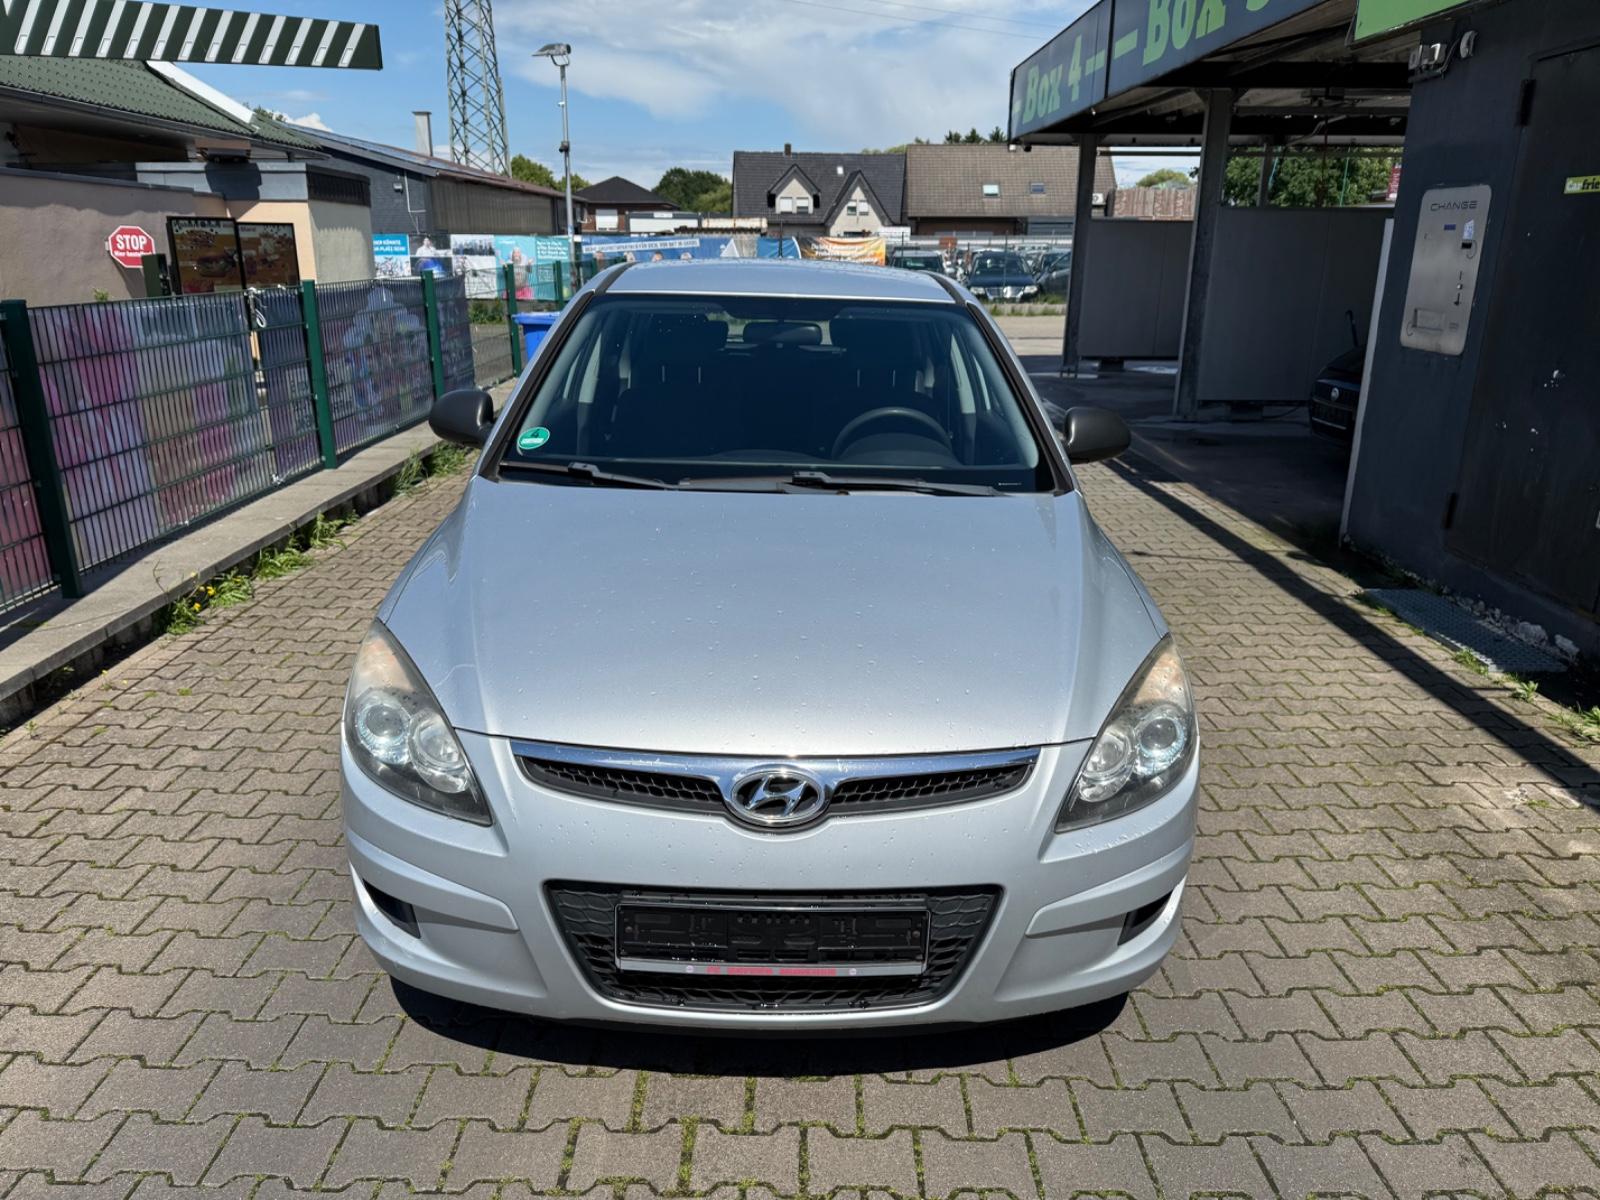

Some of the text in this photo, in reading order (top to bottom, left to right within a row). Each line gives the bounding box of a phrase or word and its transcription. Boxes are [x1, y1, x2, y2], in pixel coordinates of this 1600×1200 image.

[1022, 34, 1082, 125] Box 4
[1430, 200, 1478, 212] CHANGE
[115, 233, 147, 251] STOP
